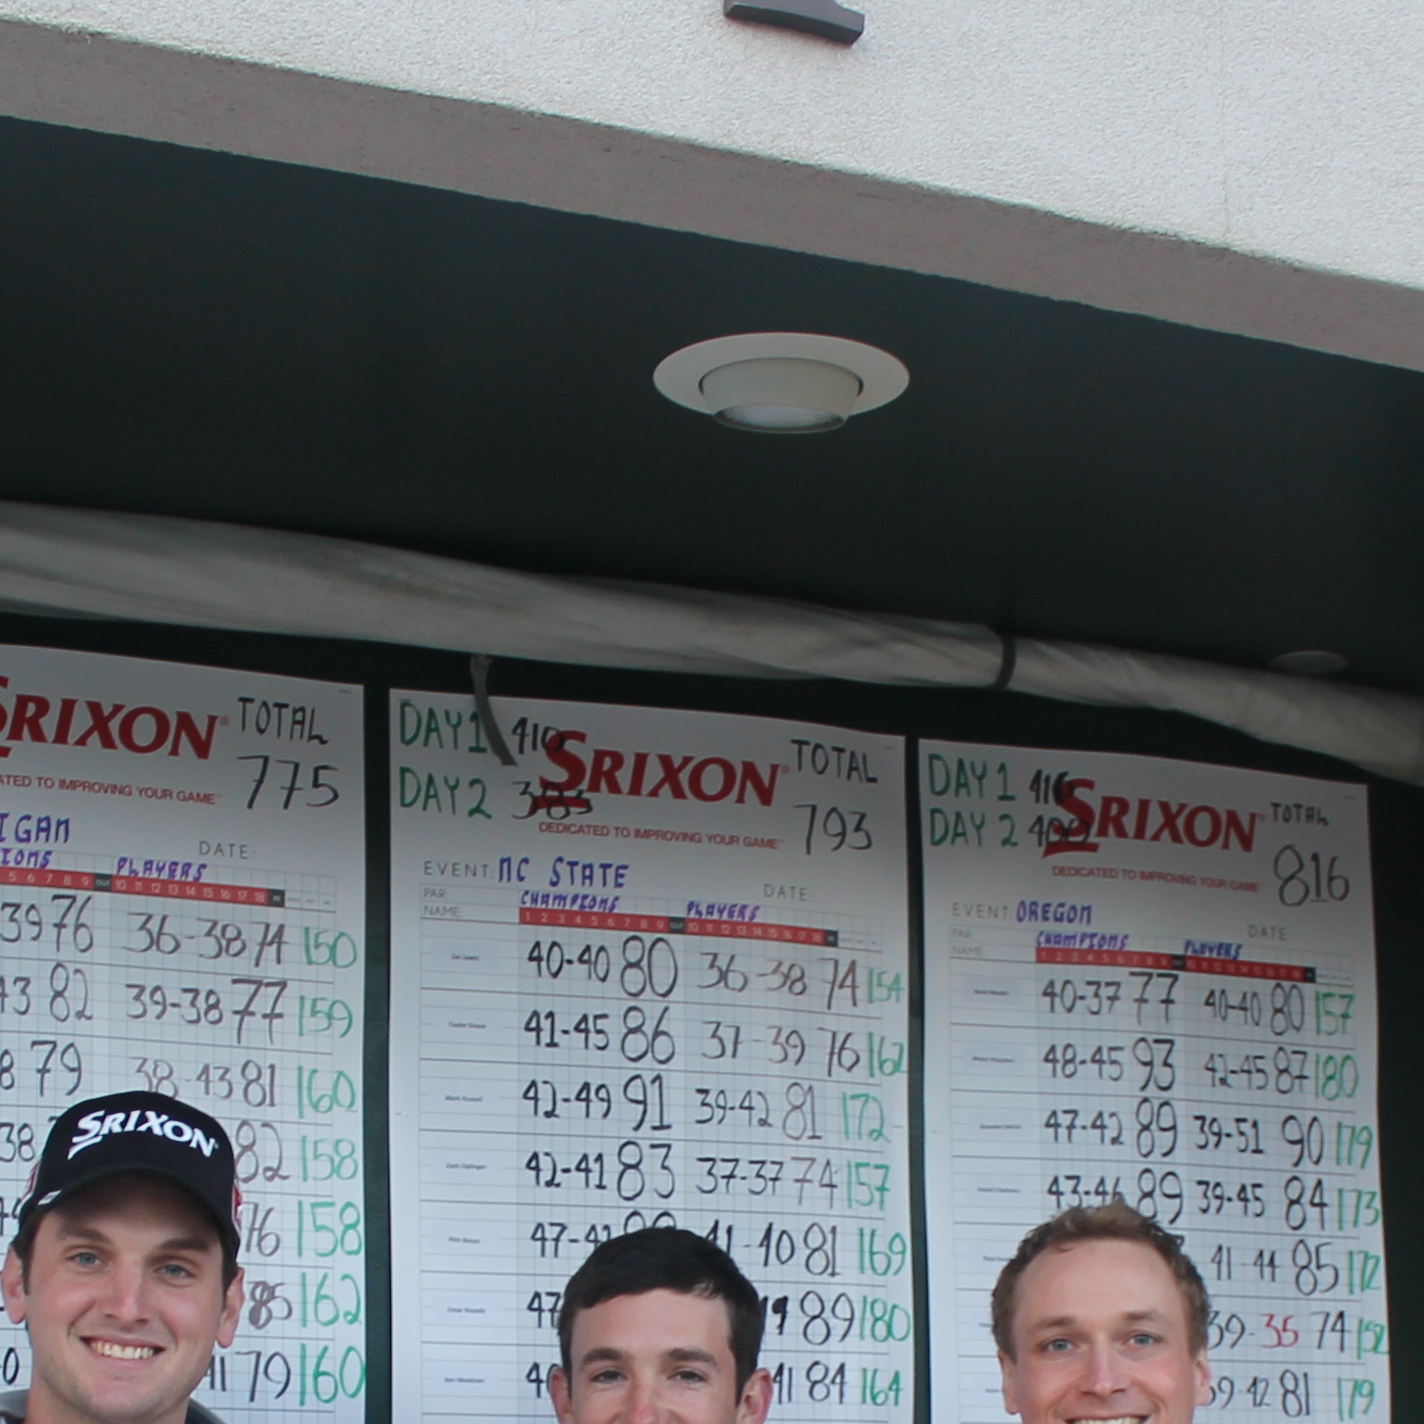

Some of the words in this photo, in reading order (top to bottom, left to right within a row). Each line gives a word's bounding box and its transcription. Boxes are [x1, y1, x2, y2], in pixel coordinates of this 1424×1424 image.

[238, 697, 329, 745] TOTAL
[237, 755, 339, 810] 775
[529, 730, 780, 816] SRIXON
[792, 739, 877, 784] TOTAL
[399, 767, 463, 810] DAY
[468, 778, 492, 819] 2
[1042, 778, 1258, 859] SRIXON
[1270, 801, 1329, 826] TOTAL
[198, 841, 255, 859] DATE:
[793, 803, 873, 855] 793
[116, 857, 207, 882] PLAYERS
[500, 857, 529, 883] NC
[549, 857, 629, 888] STATE
[1273, 845, 1349, 907] 816
[520, 891, 619, 912] CHAMPIONS
[687, 902, 760, 922] PLAYERS
[1017, 902, 1092, 924] OREGON
[304, 926, 357, 968] 150
[528, 940, 610, 981] 40-40
[621, 935, 677, 998] 80
[49, 964, 93, 1023] 82
[297, 995, 353, 1039] 159
[1042, 980, 1121, 1015] 40-37
[1128, 972, 1178, 1025] 77
[1316, 992, 1354, 1036] 157
[524, 1010, 610, 1050] 41-45
[621, 1005, 675, 1065] 86
[67, 1110, 216, 1160] SRIXON
[299, 1134, 358, 1181] 158
[1197, 1181, 1265, 1218] 39-45
[1285, 1176, 1328, 1231] 84
[1317, 1310, 1350, 1353] 74
[239, 1350, 290, 1403] 79
[299, 1344, 366, 1407] 160
